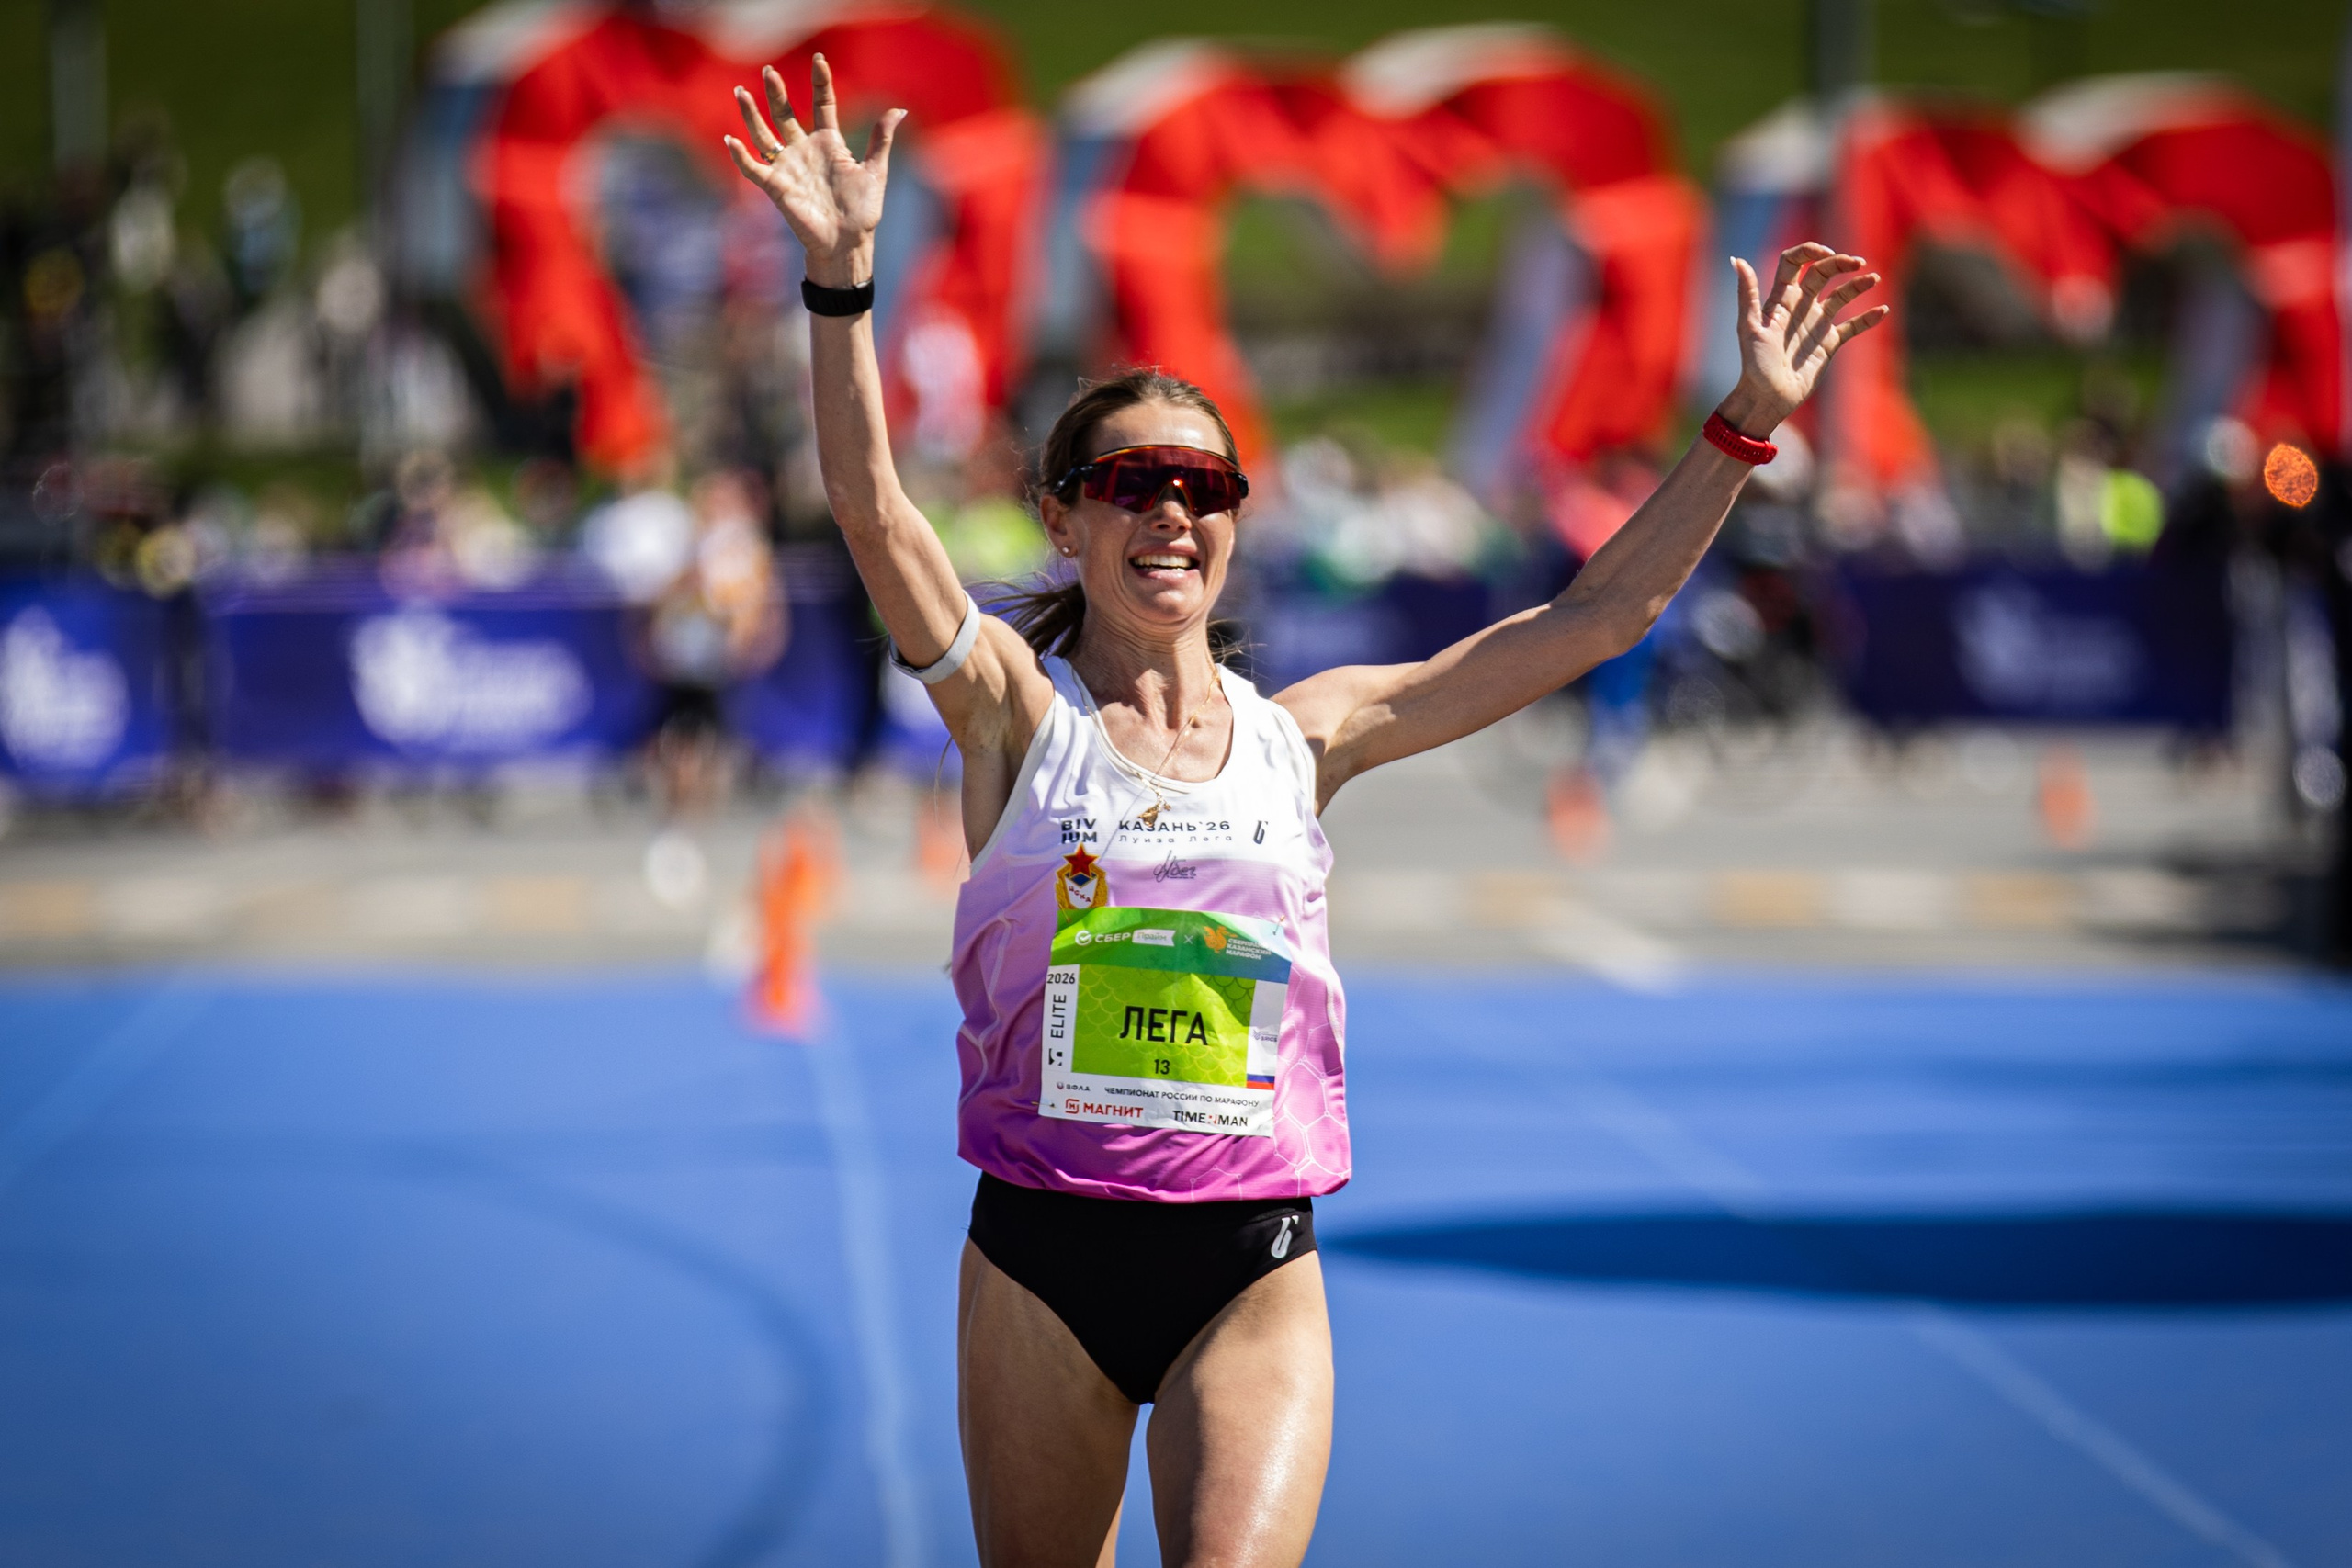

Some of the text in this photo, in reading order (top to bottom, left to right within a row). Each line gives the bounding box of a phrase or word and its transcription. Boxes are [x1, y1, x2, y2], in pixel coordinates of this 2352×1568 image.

[1118, 835, 1175, 844] Луиза
[1068, 886, 1091, 903] ЦСКА
[1094, 932, 1132, 943] СБЕР
[1046, 973, 1076, 984] 2026
[1050, 994, 1067, 1039] ELITE
[1119, 1005, 1208, 1046] ЛЕГА
[1154, 1059, 1170, 1075] 13
[1104, 1087, 1260, 1108] ЧЕМПИОНАТ РОССИИ ПО МАРАФОНУ
[1083, 1102, 1144, 1118] МАГНИТ
